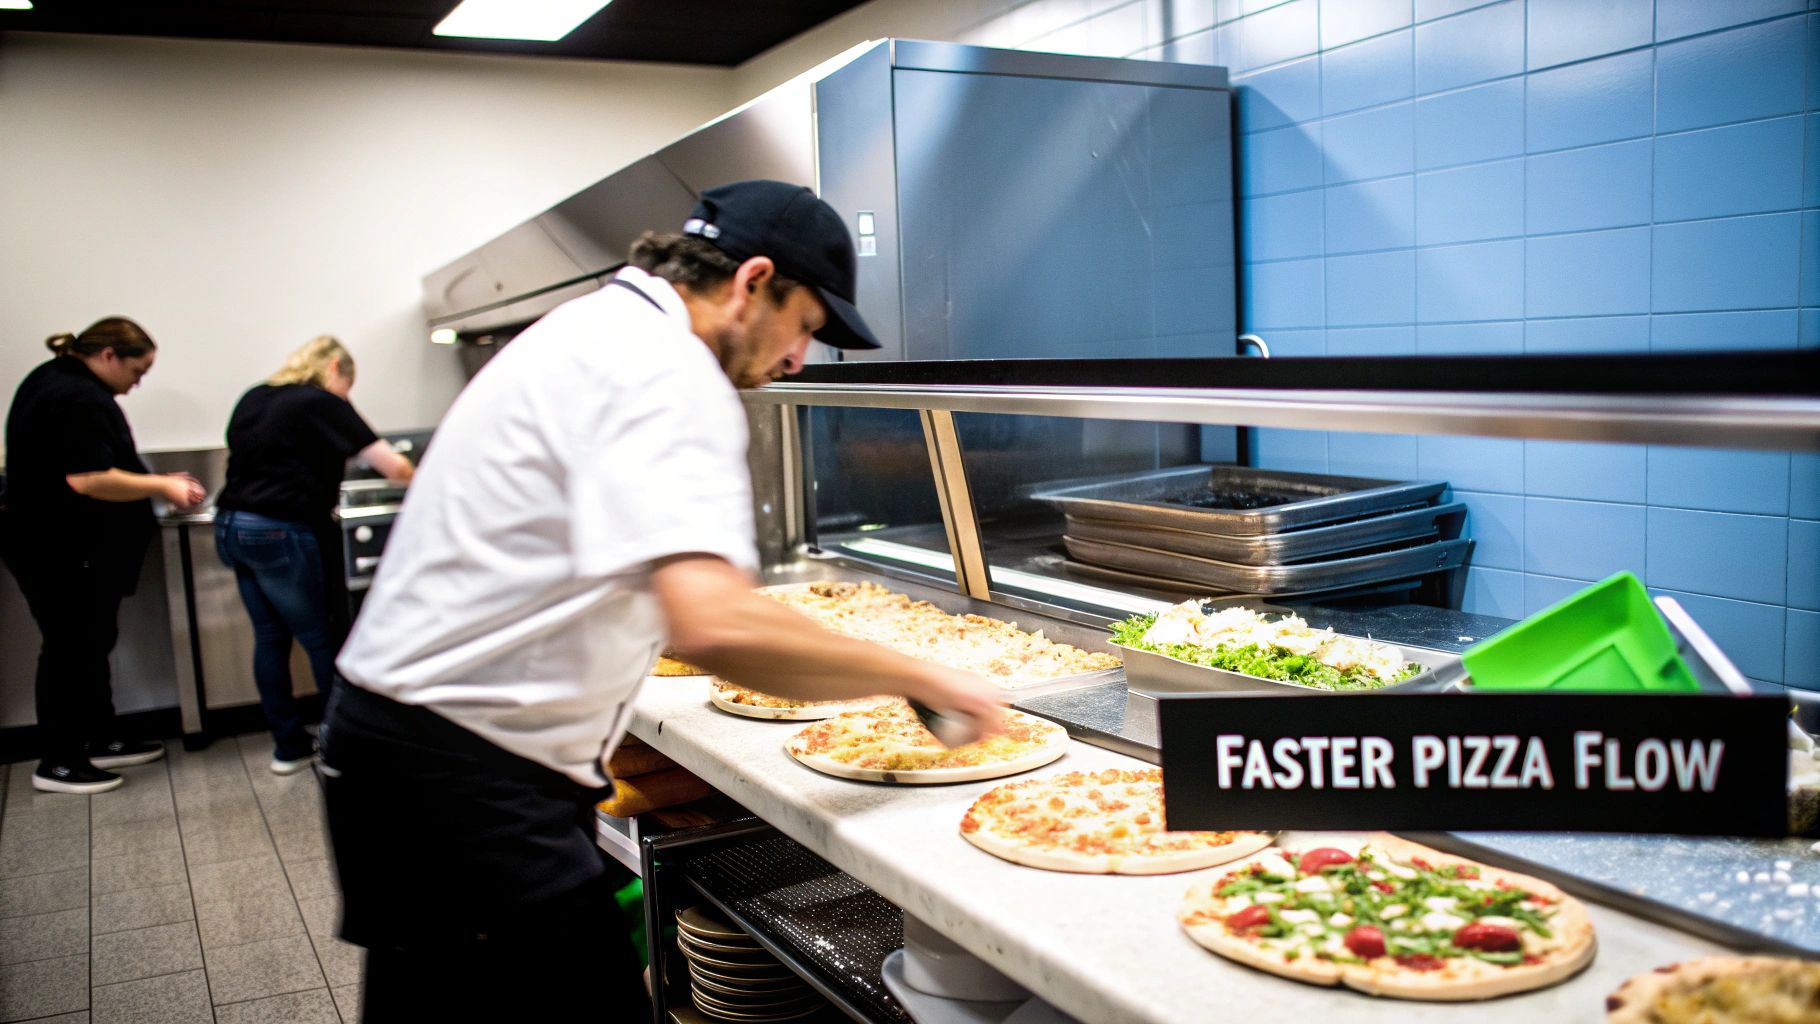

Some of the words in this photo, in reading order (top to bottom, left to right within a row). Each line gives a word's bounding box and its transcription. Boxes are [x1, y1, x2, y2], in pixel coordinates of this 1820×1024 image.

[1216, 734, 1396, 790] FASTER
[1411, 735, 1554, 789] PIZZA
[1574, 730, 1725, 792] FLOW
